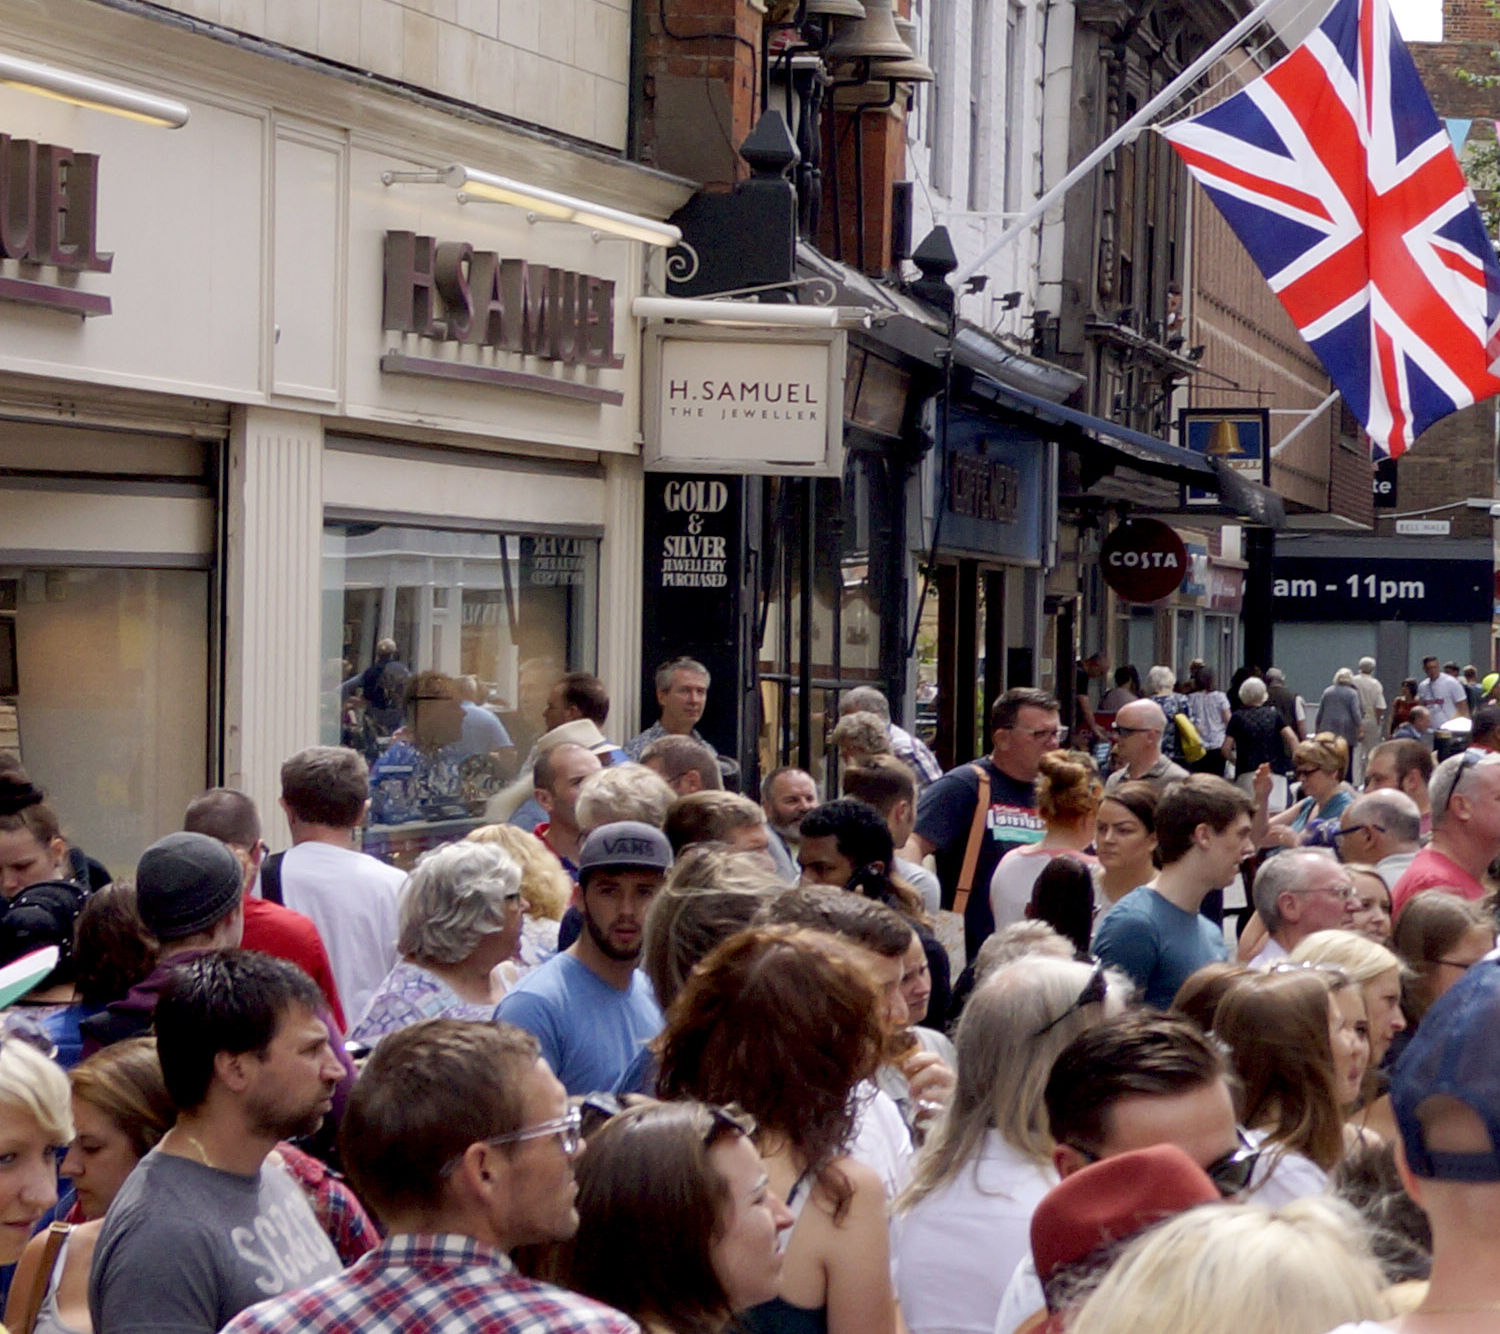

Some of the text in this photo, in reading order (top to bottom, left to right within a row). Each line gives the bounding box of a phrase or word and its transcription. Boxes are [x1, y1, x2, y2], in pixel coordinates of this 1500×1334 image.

[670, 407, 817, 421] THE JEWELLER
[664, 481, 728, 513] GOLD
[688, 513, 704, 534] &
[663, 536, 727, 558] SILVER
[661, 559, 727, 572] JEWELLERY
[1109, 551, 1178, 570] COSTA
[662, 573, 728, 587] PURCHASED
[1346, 574, 1425, 604] 11pm
[603, 837, 656, 857] VANS
